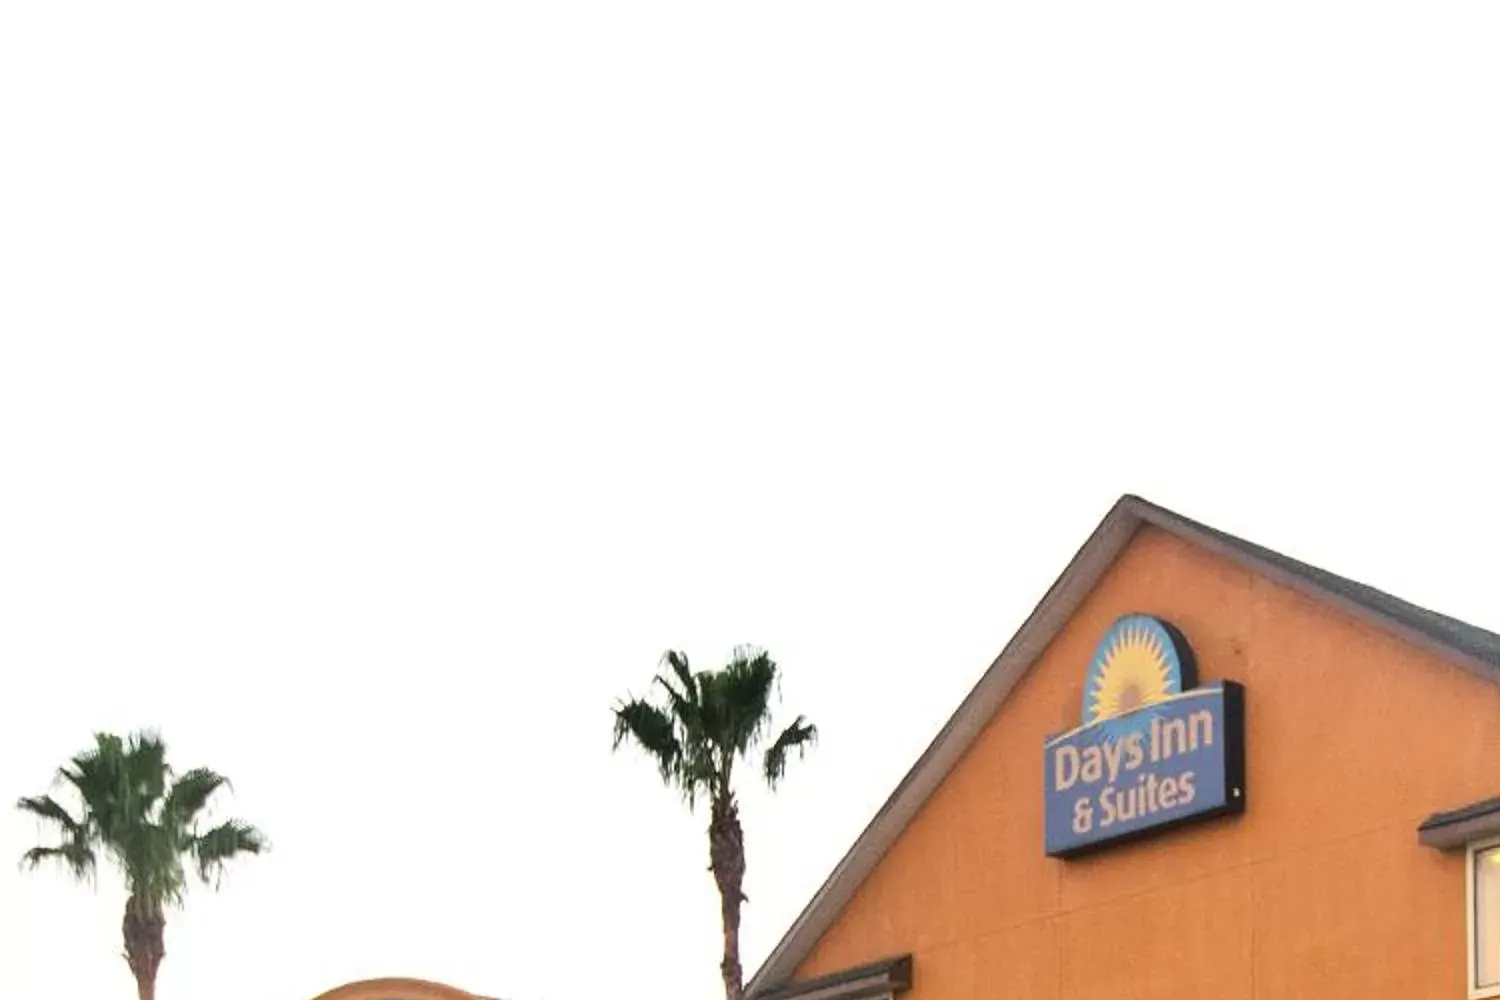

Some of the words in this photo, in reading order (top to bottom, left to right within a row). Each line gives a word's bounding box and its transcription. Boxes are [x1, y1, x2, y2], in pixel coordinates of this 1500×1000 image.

[1055, 731, 1144, 791] Days
[1150, 709, 1213, 762] Inn
[1072, 796, 1095, 834] &
[1099, 771, 1196, 827] Suites
